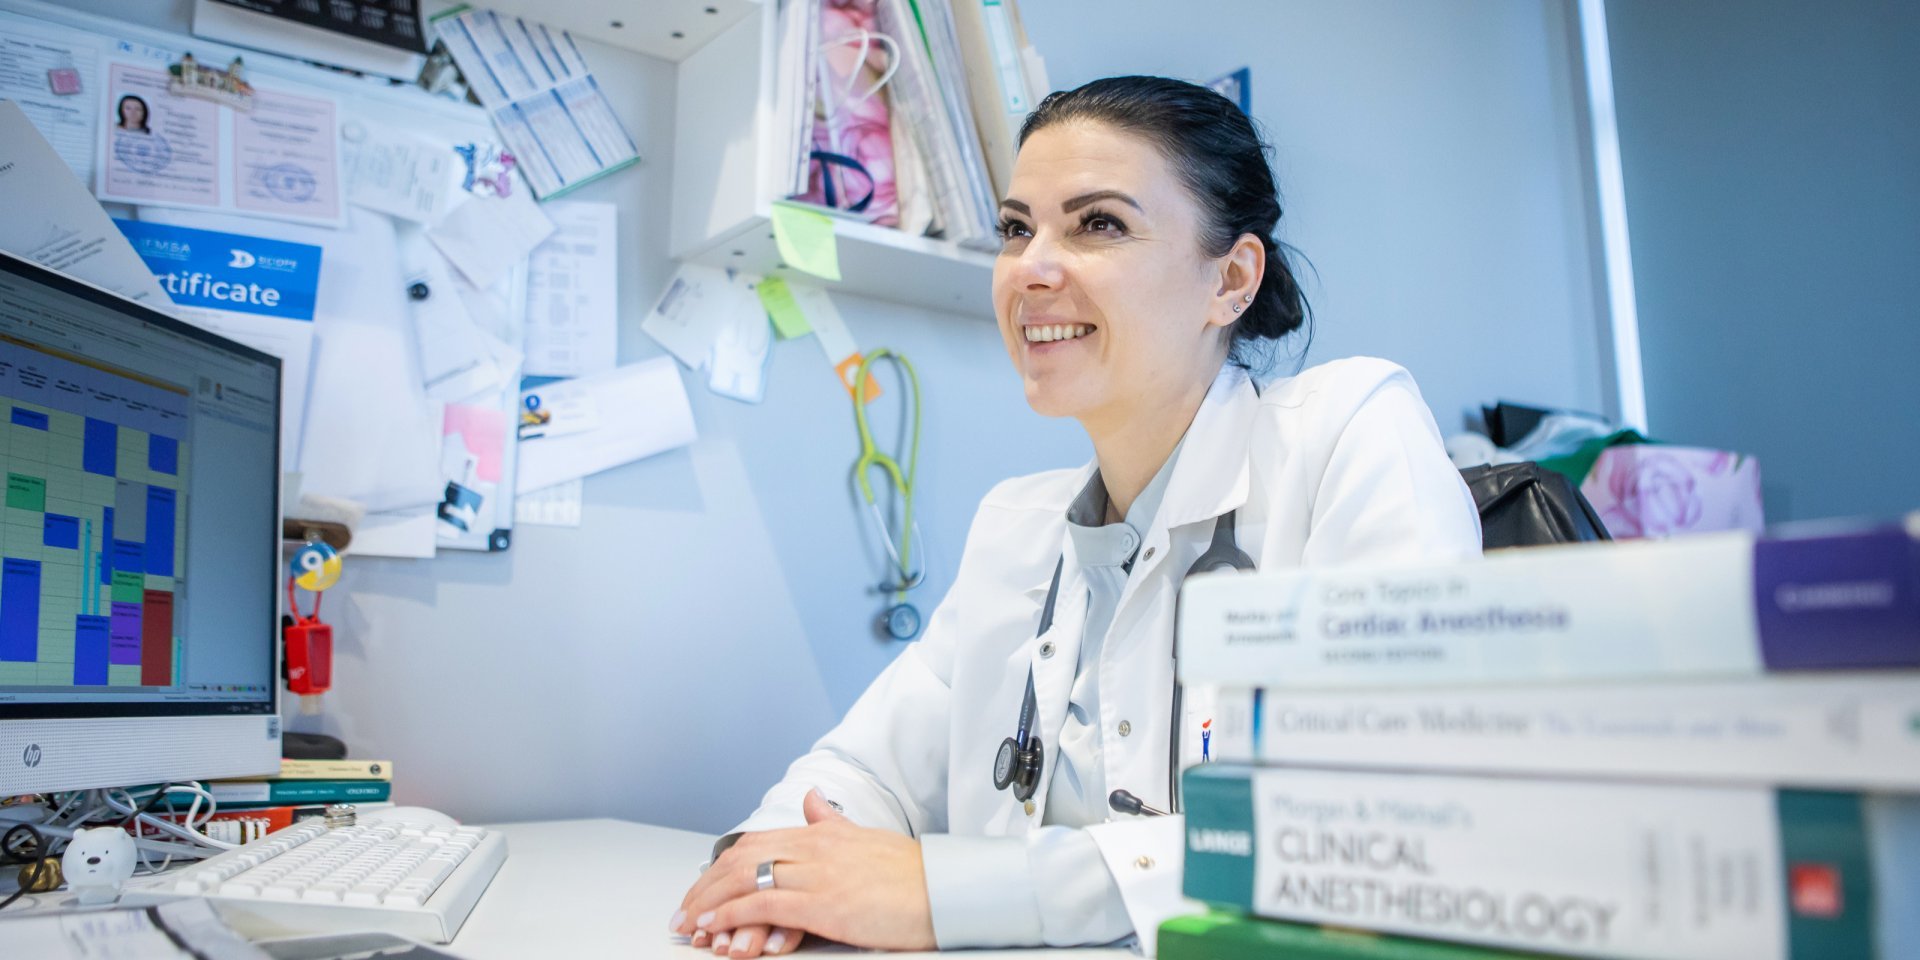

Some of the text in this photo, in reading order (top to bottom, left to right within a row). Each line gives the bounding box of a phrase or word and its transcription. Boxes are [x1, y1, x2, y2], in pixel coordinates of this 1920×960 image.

[301, 550, 325, 577] 9
[1321, 606, 1572, 639] Cardiac Anesthesia
[24, 743, 41, 767] hp
[1190, 828, 1252, 855] LANGE
[1274, 829, 1435, 873] CLINICAL
[1275, 875, 1618, 942] ANESTHESIOLOGY
